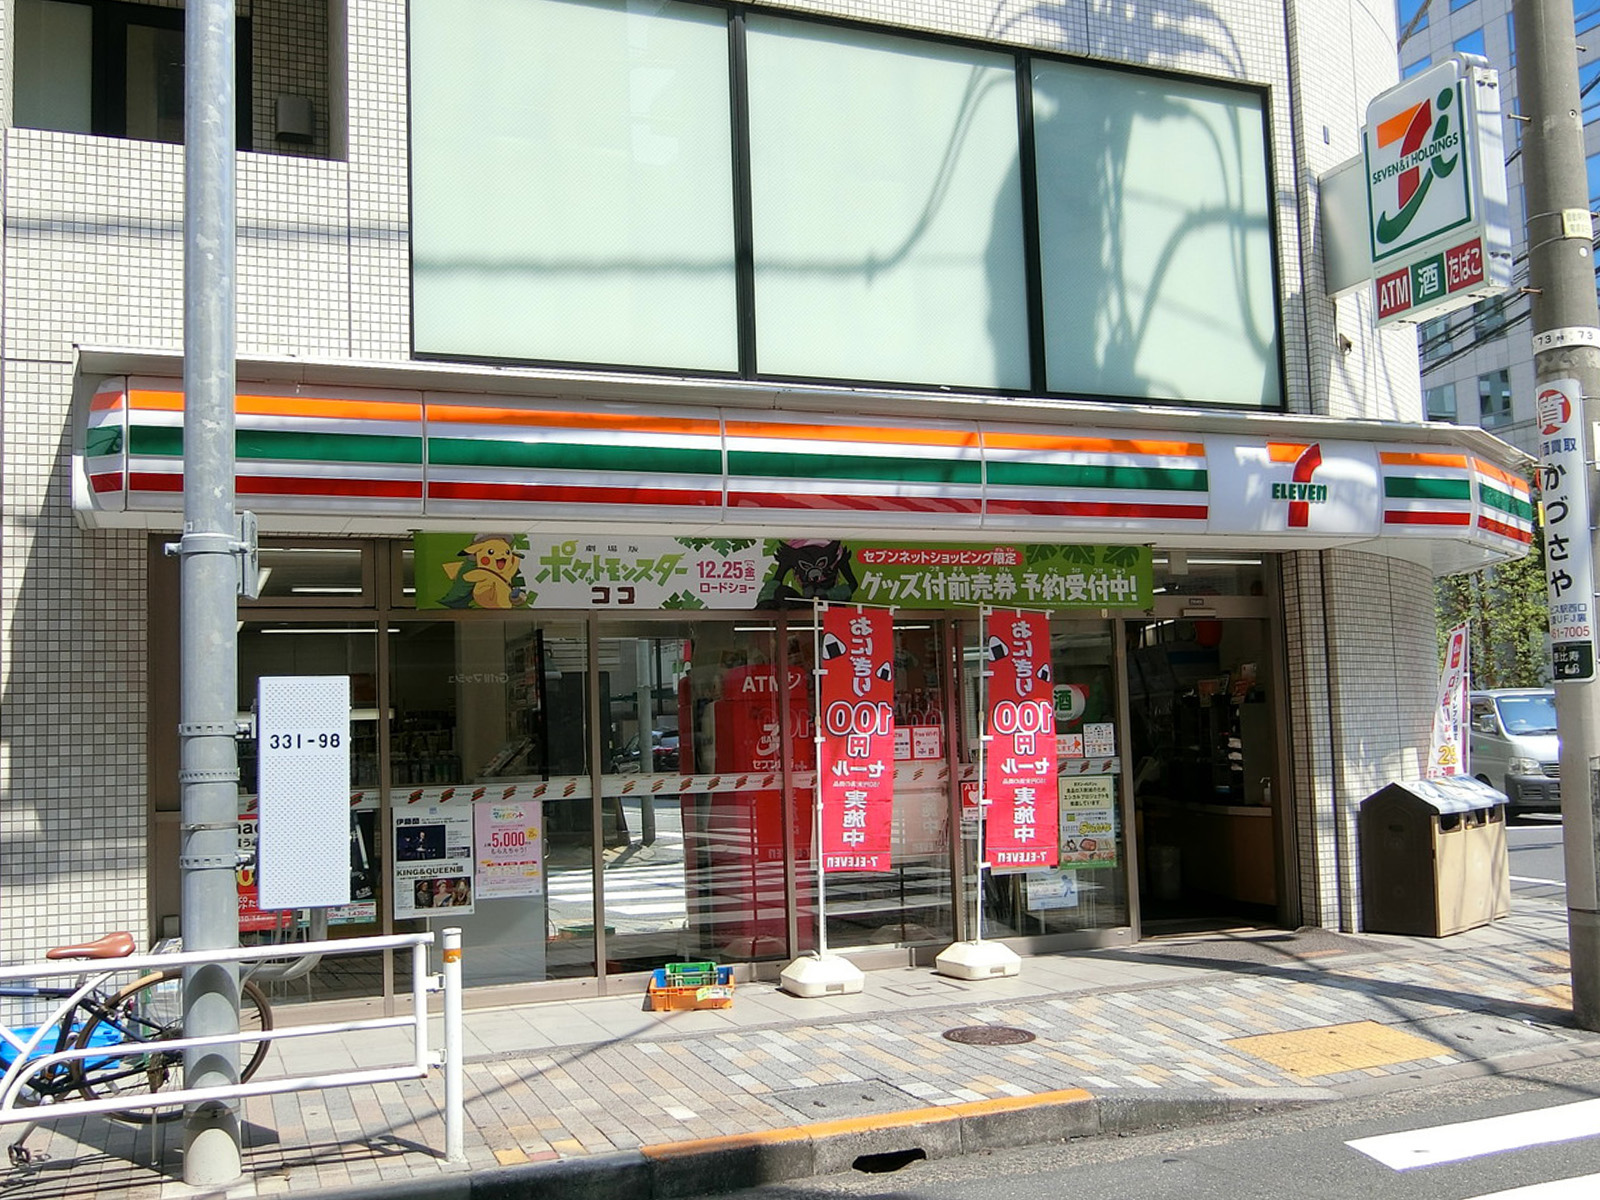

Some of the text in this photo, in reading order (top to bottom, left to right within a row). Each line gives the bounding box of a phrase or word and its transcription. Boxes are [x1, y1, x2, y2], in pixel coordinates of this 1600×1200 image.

[1411, 132, 1459, 166] HOLDINGS
[1380, 248, 1482, 312] ATM 酒 たばこ
[1544, 463, 1573, 598] かづさや
[534, 539, 689, 587] ポケットモンスター
[863, 550, 1017, 565] セブンネットショッピング限定
[591, 586, 635, 604] ココ
[699, 582, 756, 594] ロードショー
[860, 571, 1018, 601] グッズ付前売券
[1053, 689, 1072, 711] 酒
[270, 733, 341, 749] 331-98
